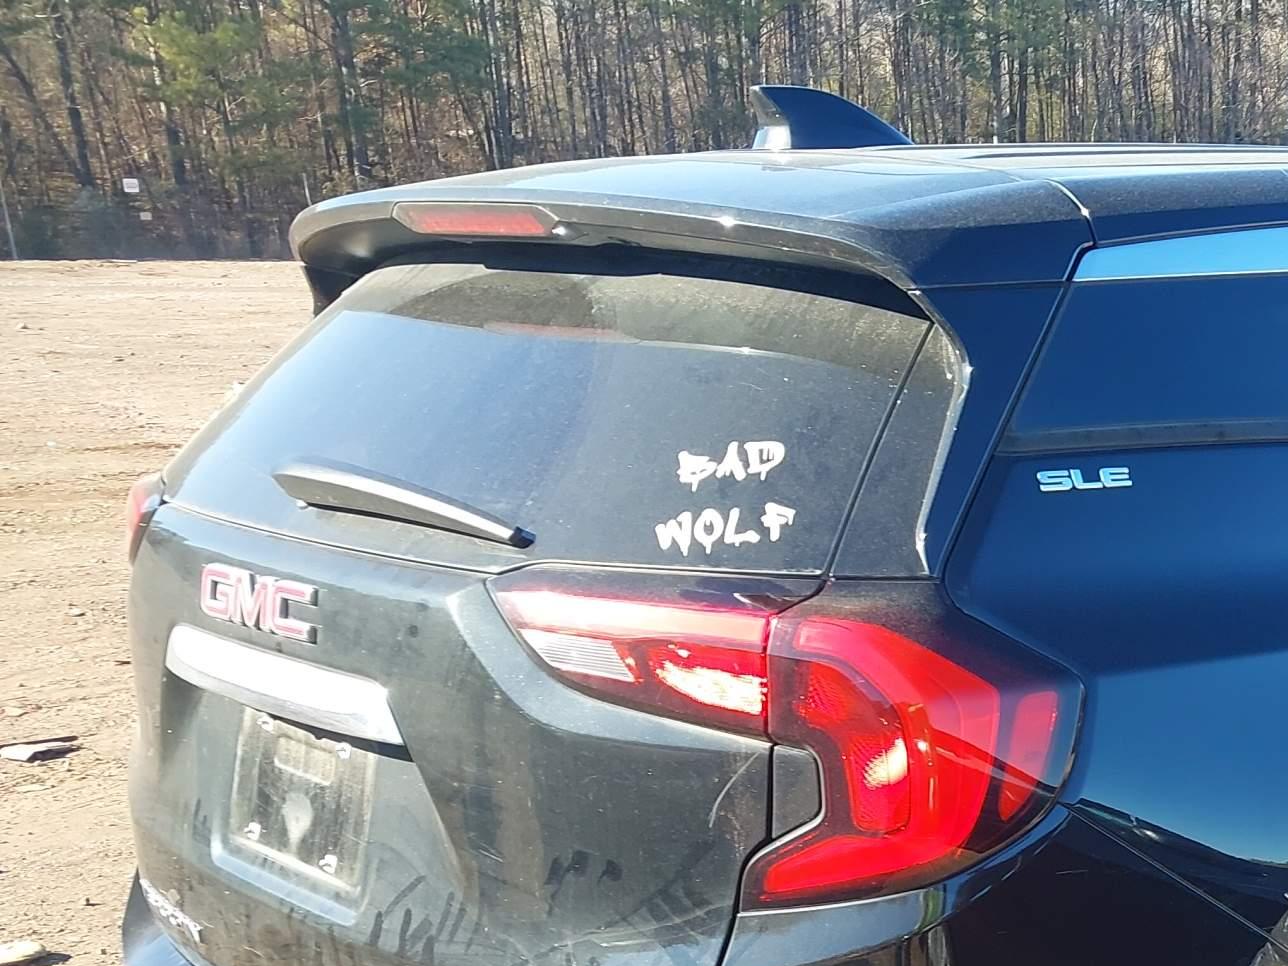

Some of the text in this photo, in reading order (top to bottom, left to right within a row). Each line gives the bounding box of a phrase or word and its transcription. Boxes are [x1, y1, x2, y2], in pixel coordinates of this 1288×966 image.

[676, 440, 785, 493] BAD
[1036, 466, 1133, 492] SLE
[655, 501, 797, 558] WOLF
[200, 562, 320, 646] GMC
